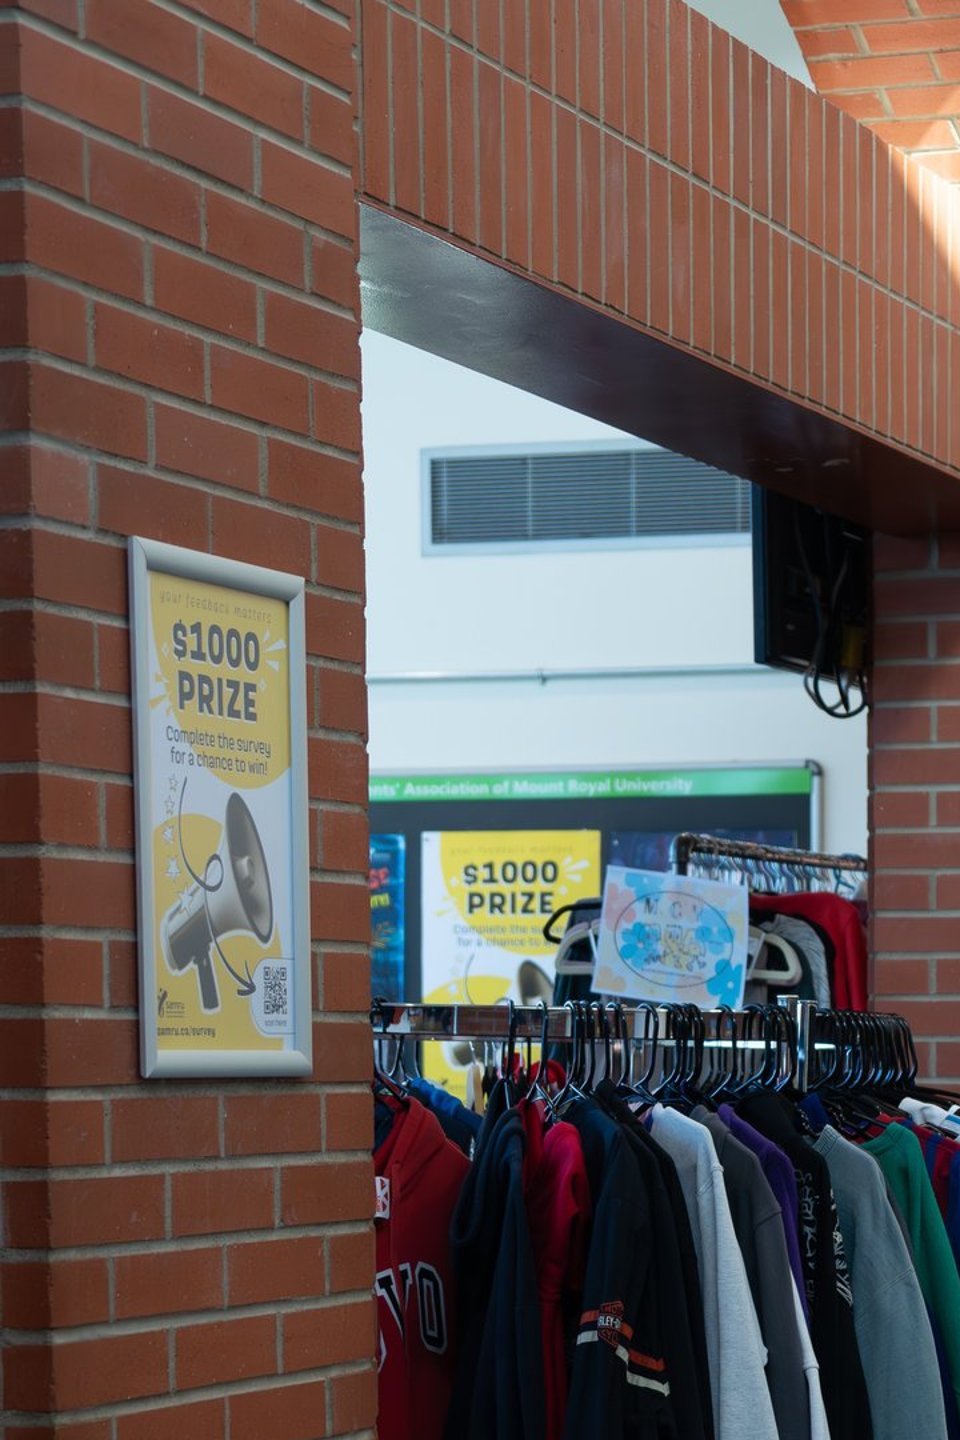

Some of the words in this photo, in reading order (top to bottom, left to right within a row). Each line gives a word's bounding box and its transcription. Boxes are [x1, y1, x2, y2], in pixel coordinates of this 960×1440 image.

[172, 619, 260, 672] $1000
[178, 670, 257, 722] PRIZE
[166, 725, 216, 748] Complete
[217, 732, 234, 750] the
[237, 737, 271, 758] survey
[170, 746, 185, 764] for
[188, 752, 195, 766] a
[197, 751, 233, 771] chance
[235, 758, 245, 773] to
[248, 758, 268, 776] win!
[404, 781, 489, 796] Association
[493, 779, 509, 794] of
[512, 779, 564, 794] Mount
[569, 776, 610, 795] Royal
[614, 776, 693, 795] University
[463, 861, 559, 885] $1000
[468, 892, 554, 915] PRIZE
